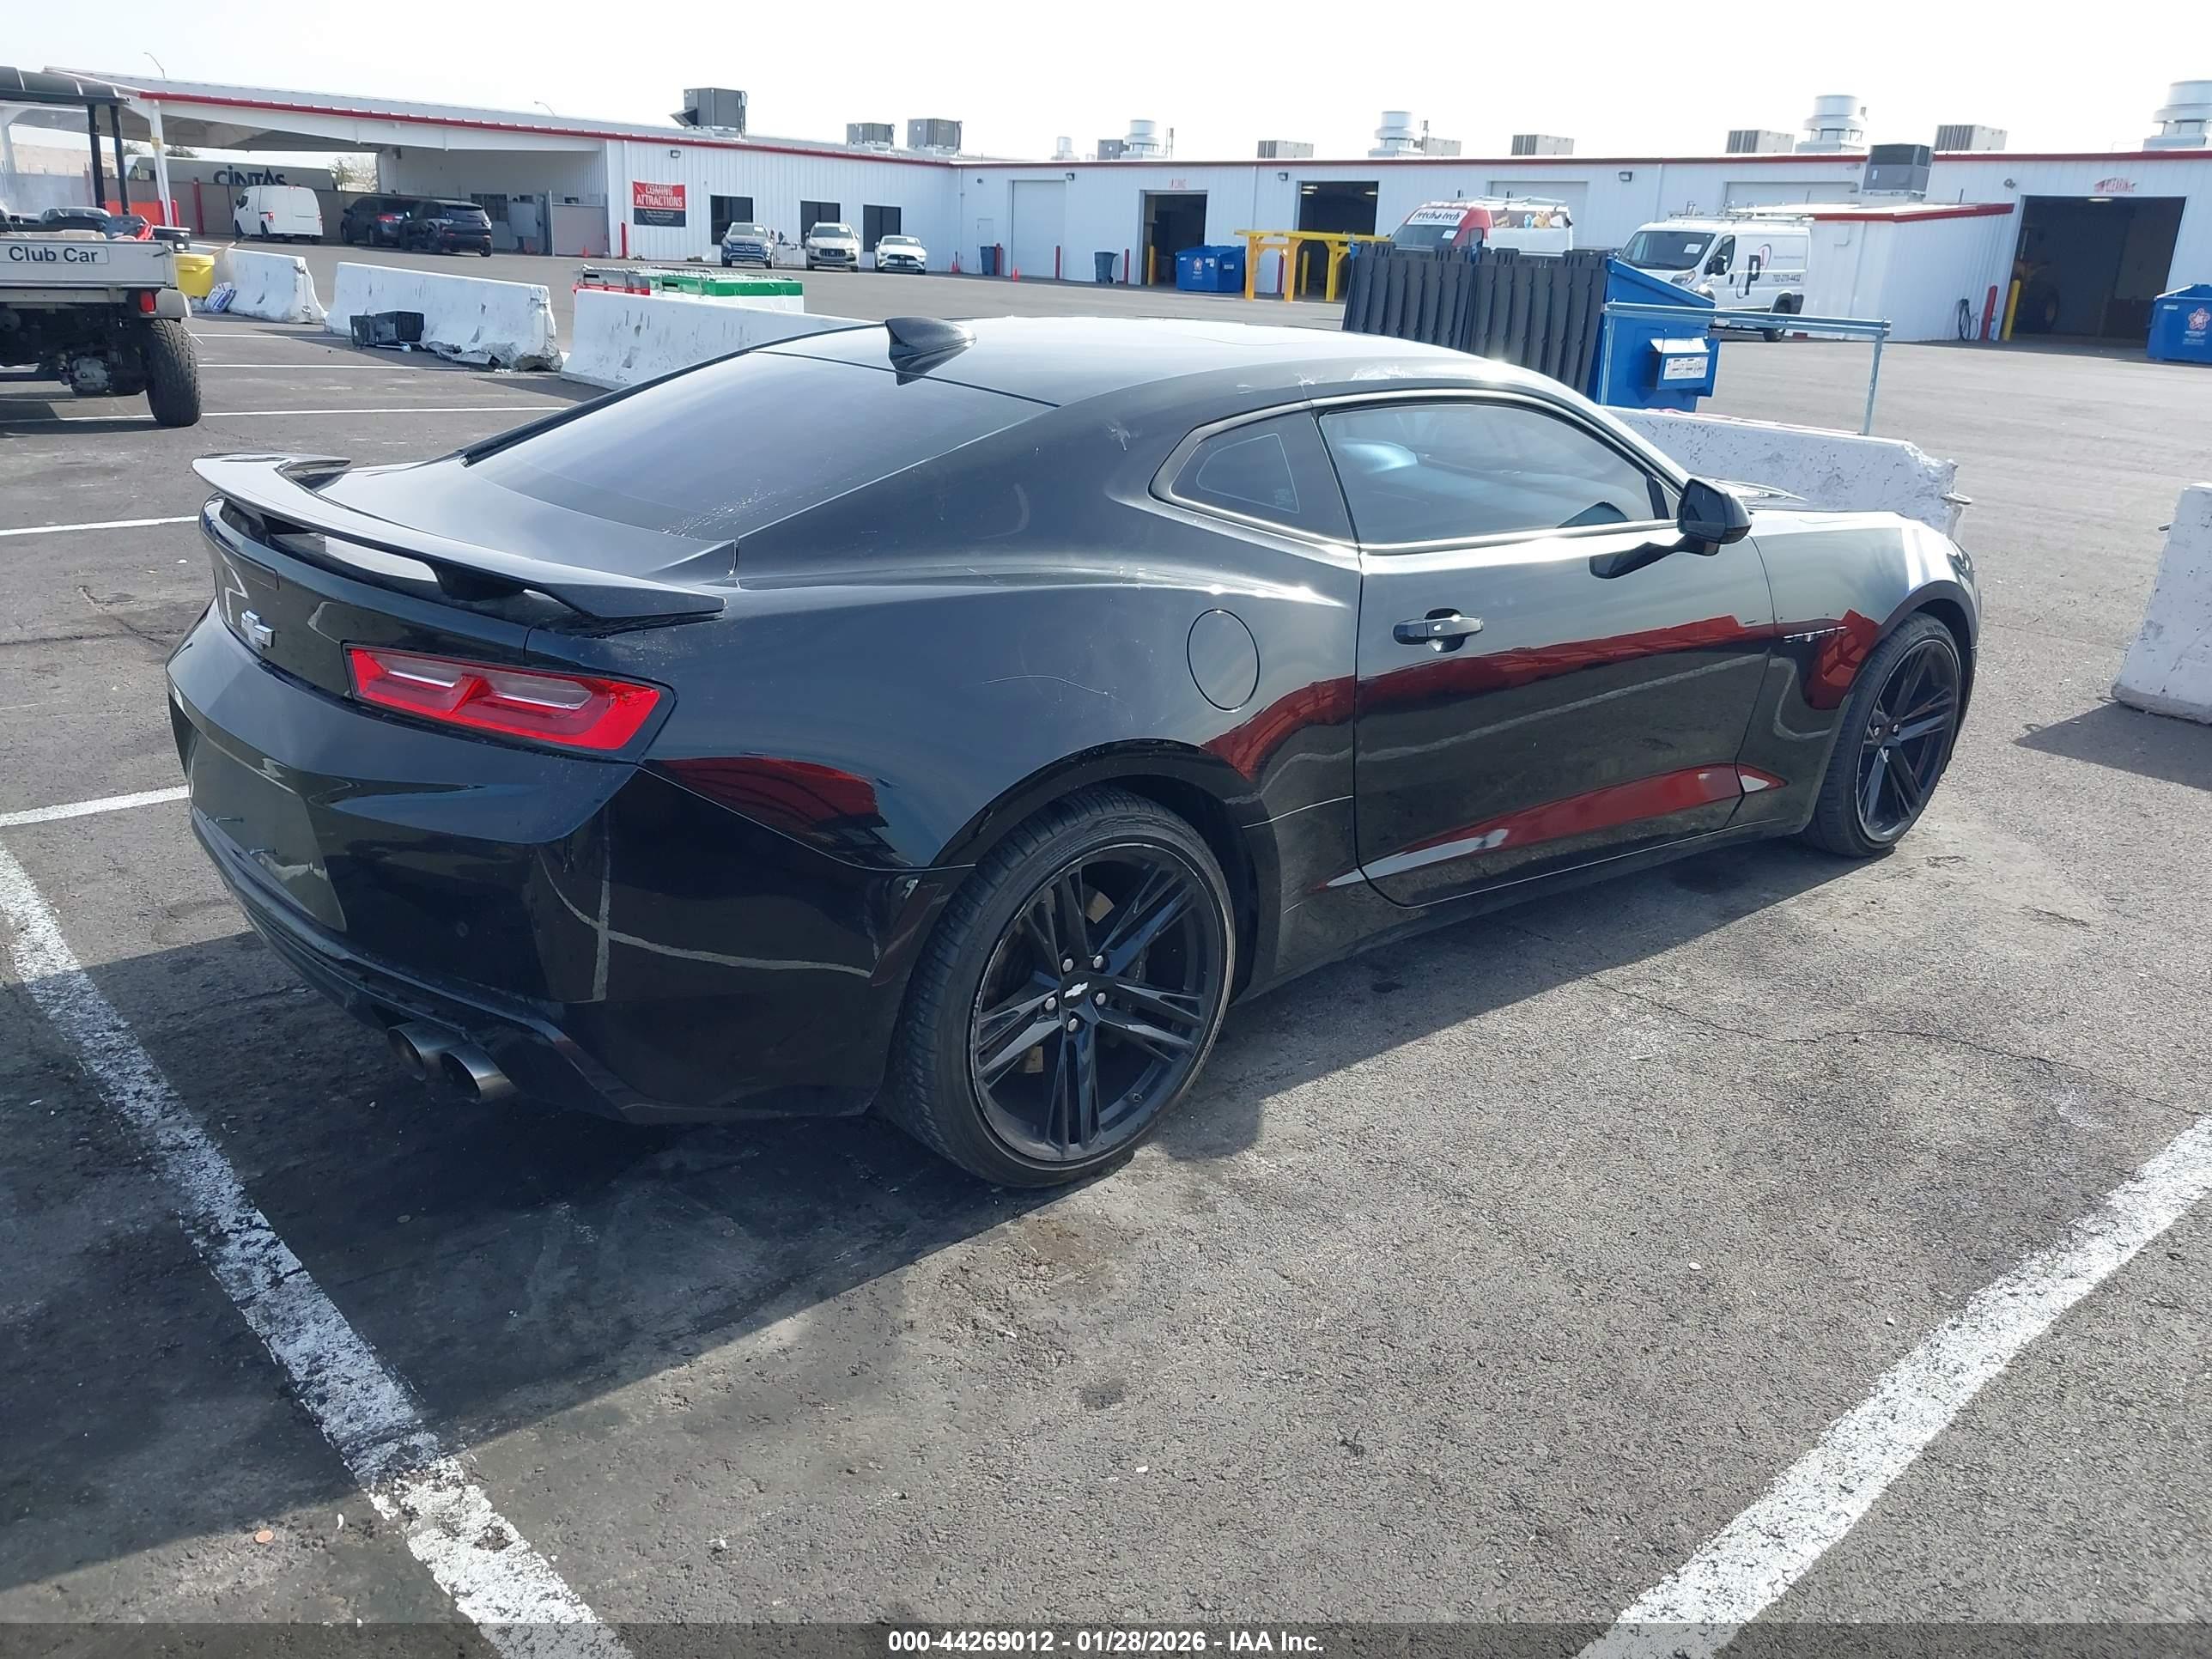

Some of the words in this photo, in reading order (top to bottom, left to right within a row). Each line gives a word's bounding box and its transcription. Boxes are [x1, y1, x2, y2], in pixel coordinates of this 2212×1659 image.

[646, 184, 673, 196] COMING
[636, 193, 683, 207] ATTRACTIONS
[9, 246, 57, 262] Club
[64, 247, 99, 263] Car
